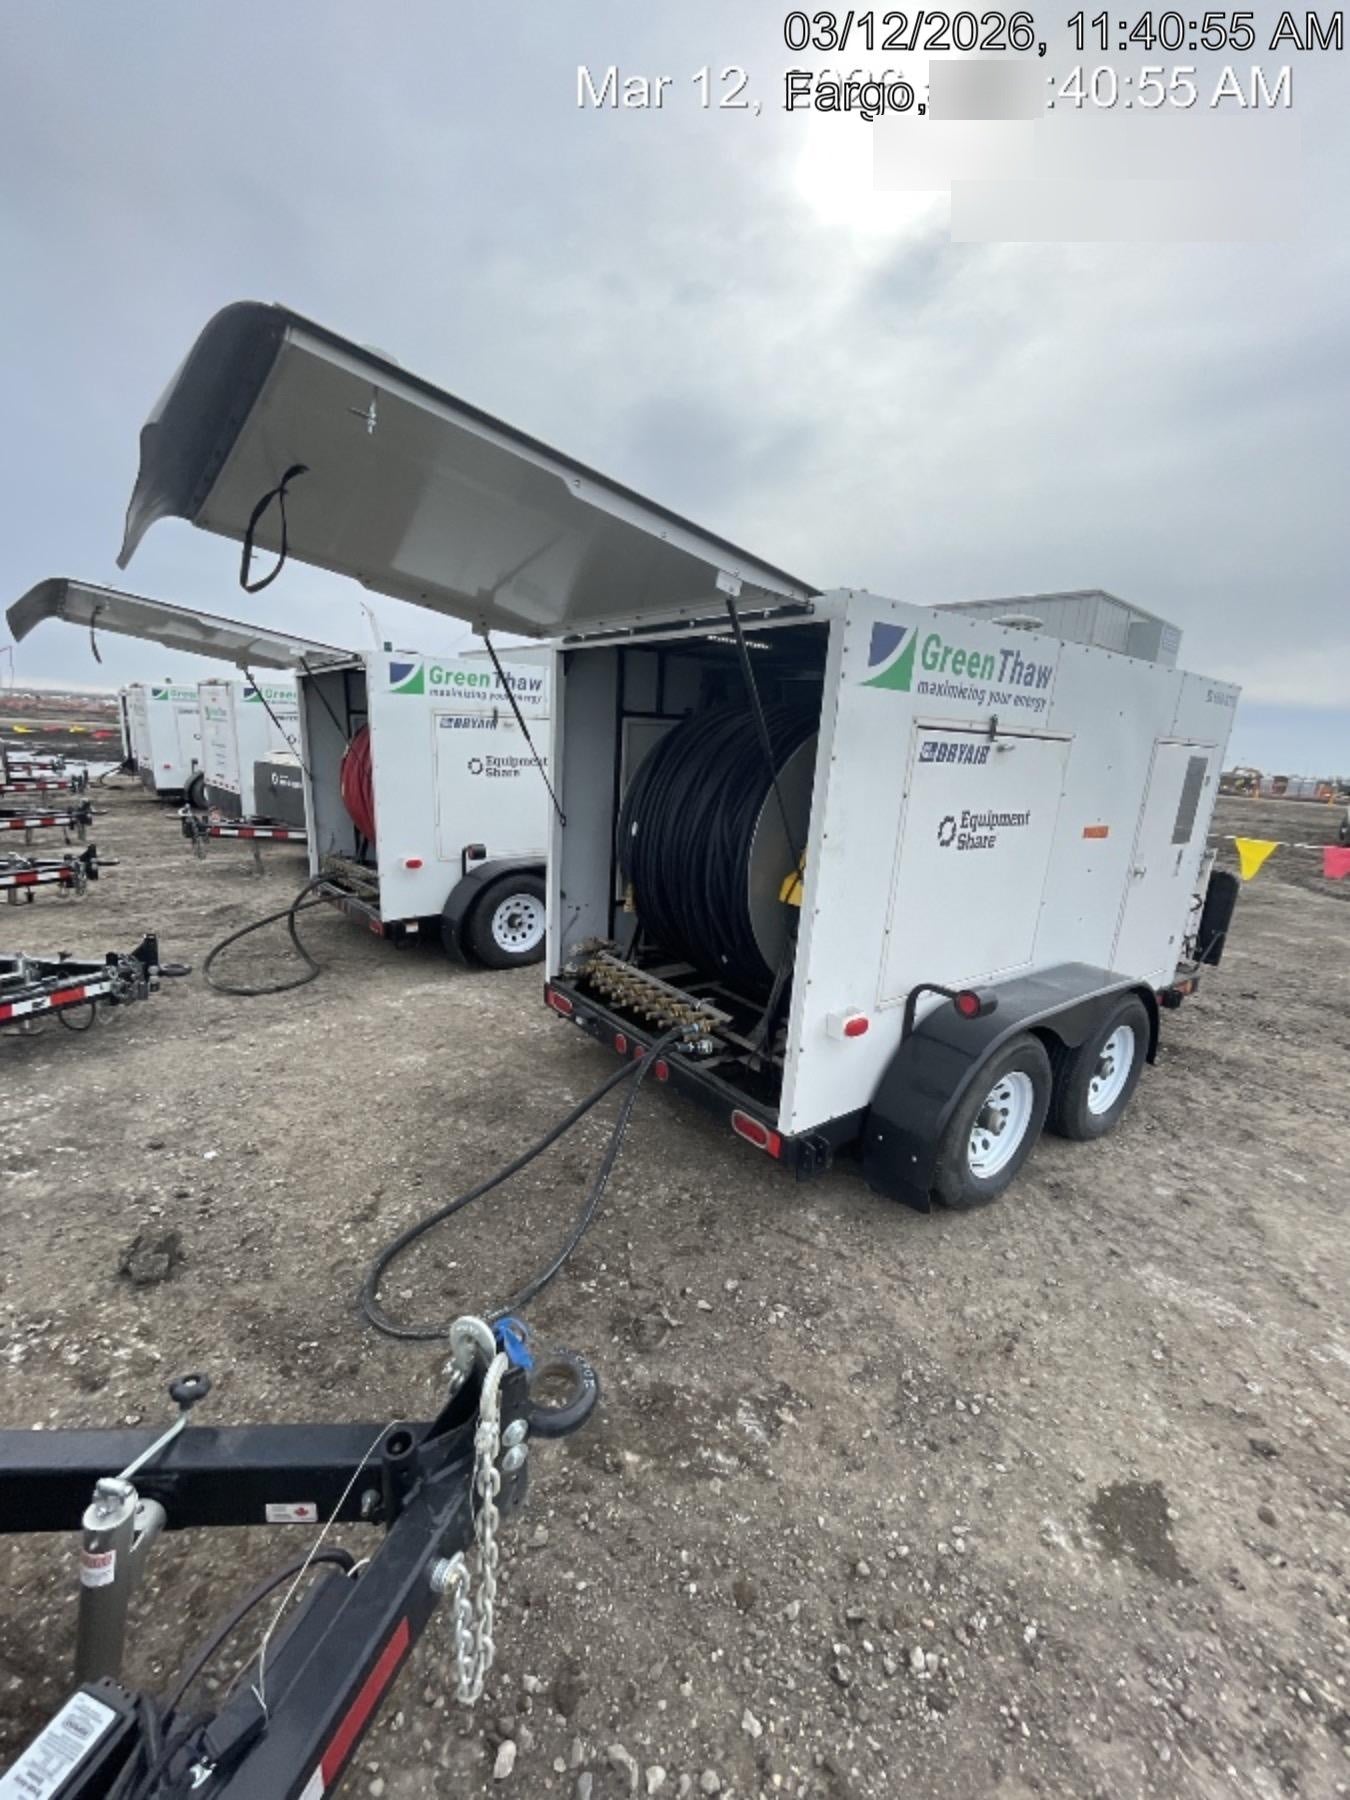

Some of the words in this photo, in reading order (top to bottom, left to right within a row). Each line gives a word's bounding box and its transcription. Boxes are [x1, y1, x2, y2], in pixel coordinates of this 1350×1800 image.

[917, 679, 987, 706] maximizing
[987, 691, 1012, 706] your
[1013, 694, 1047, 712] energy
[960, 810, 1031, 832] Equipment
[957, 833, 997, 850] Share
